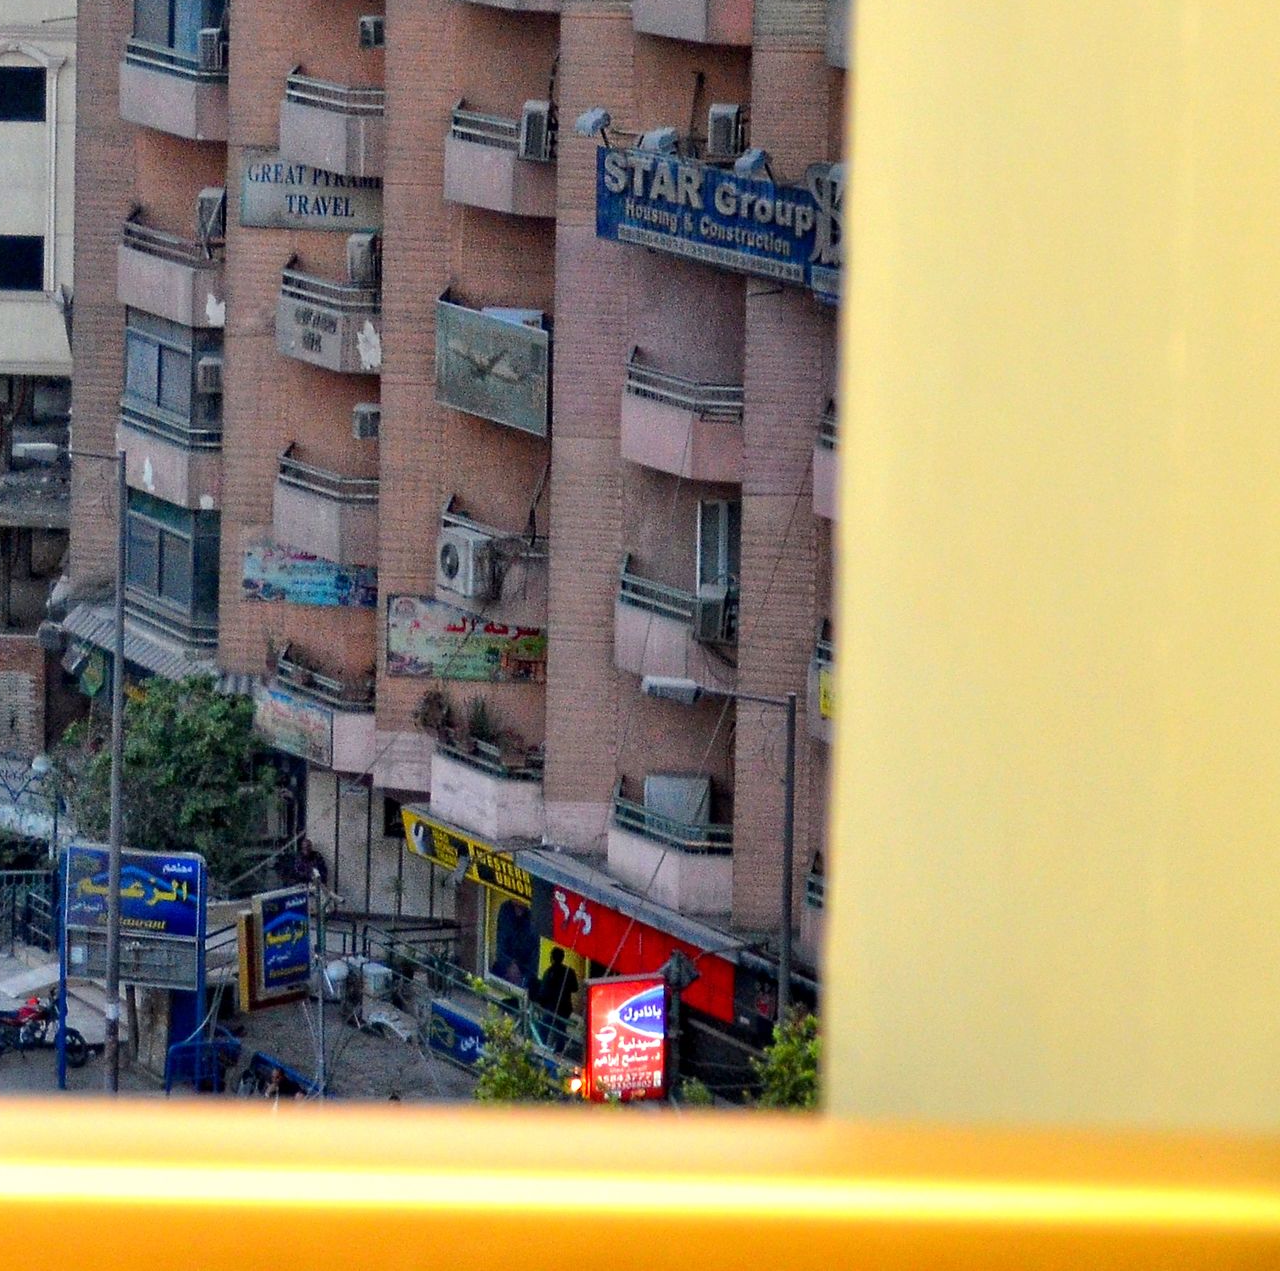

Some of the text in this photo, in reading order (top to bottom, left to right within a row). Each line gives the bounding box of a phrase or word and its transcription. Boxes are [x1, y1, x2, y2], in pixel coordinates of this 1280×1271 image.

[248, 163, 307, 186] GREAT
[285, 194, 355, 218] TRAVEL
[604, 151, 817, 239] STAR Group
[625, 200, 678, 233] Housing
[700, 215, 791, 257] Construction
[77, 877, 188, 906] الزعم
[495, 871, 532, 898] UNION
[97, 913, 168, 930] Rtaurant
[624, 1004, 662, 1022] بانادول
[618, 1036, 661, 1051] صيدلية
[622, 1051, 649, 1067] سامح
